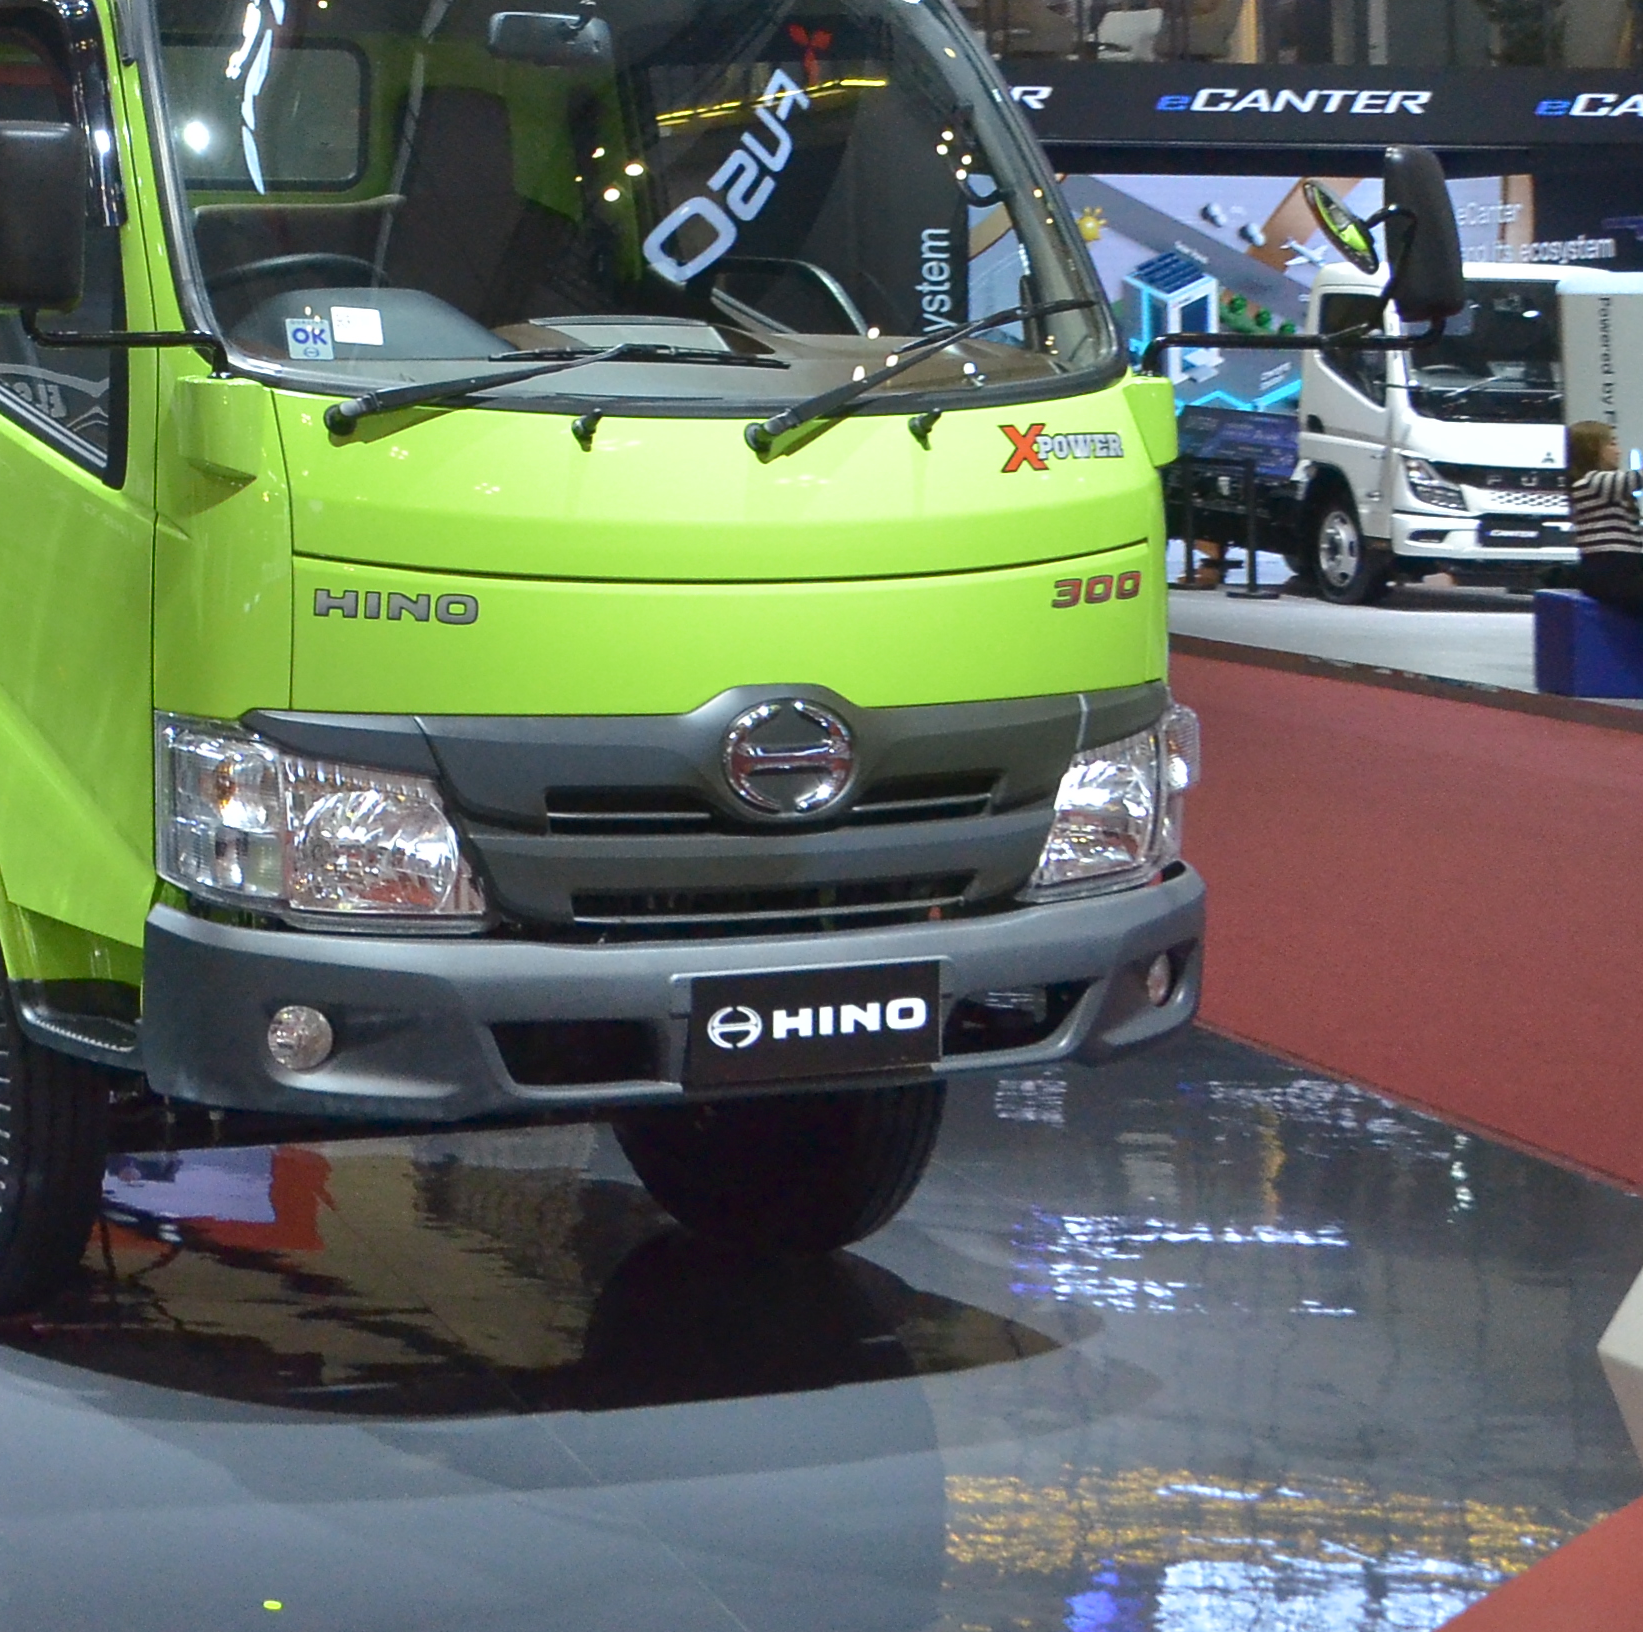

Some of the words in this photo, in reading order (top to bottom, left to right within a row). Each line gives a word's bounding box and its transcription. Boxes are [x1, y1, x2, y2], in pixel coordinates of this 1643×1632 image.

[1155, 86, 1433, 116] eCANTER
[1520, 234, 1616, 265] ecosystem
[291, 327, 328, 345] OK
[313, 586, 479, 626] HINO
[1051, 570, 1142, 608] 300
[771, 994, 927, 1042] HINO
